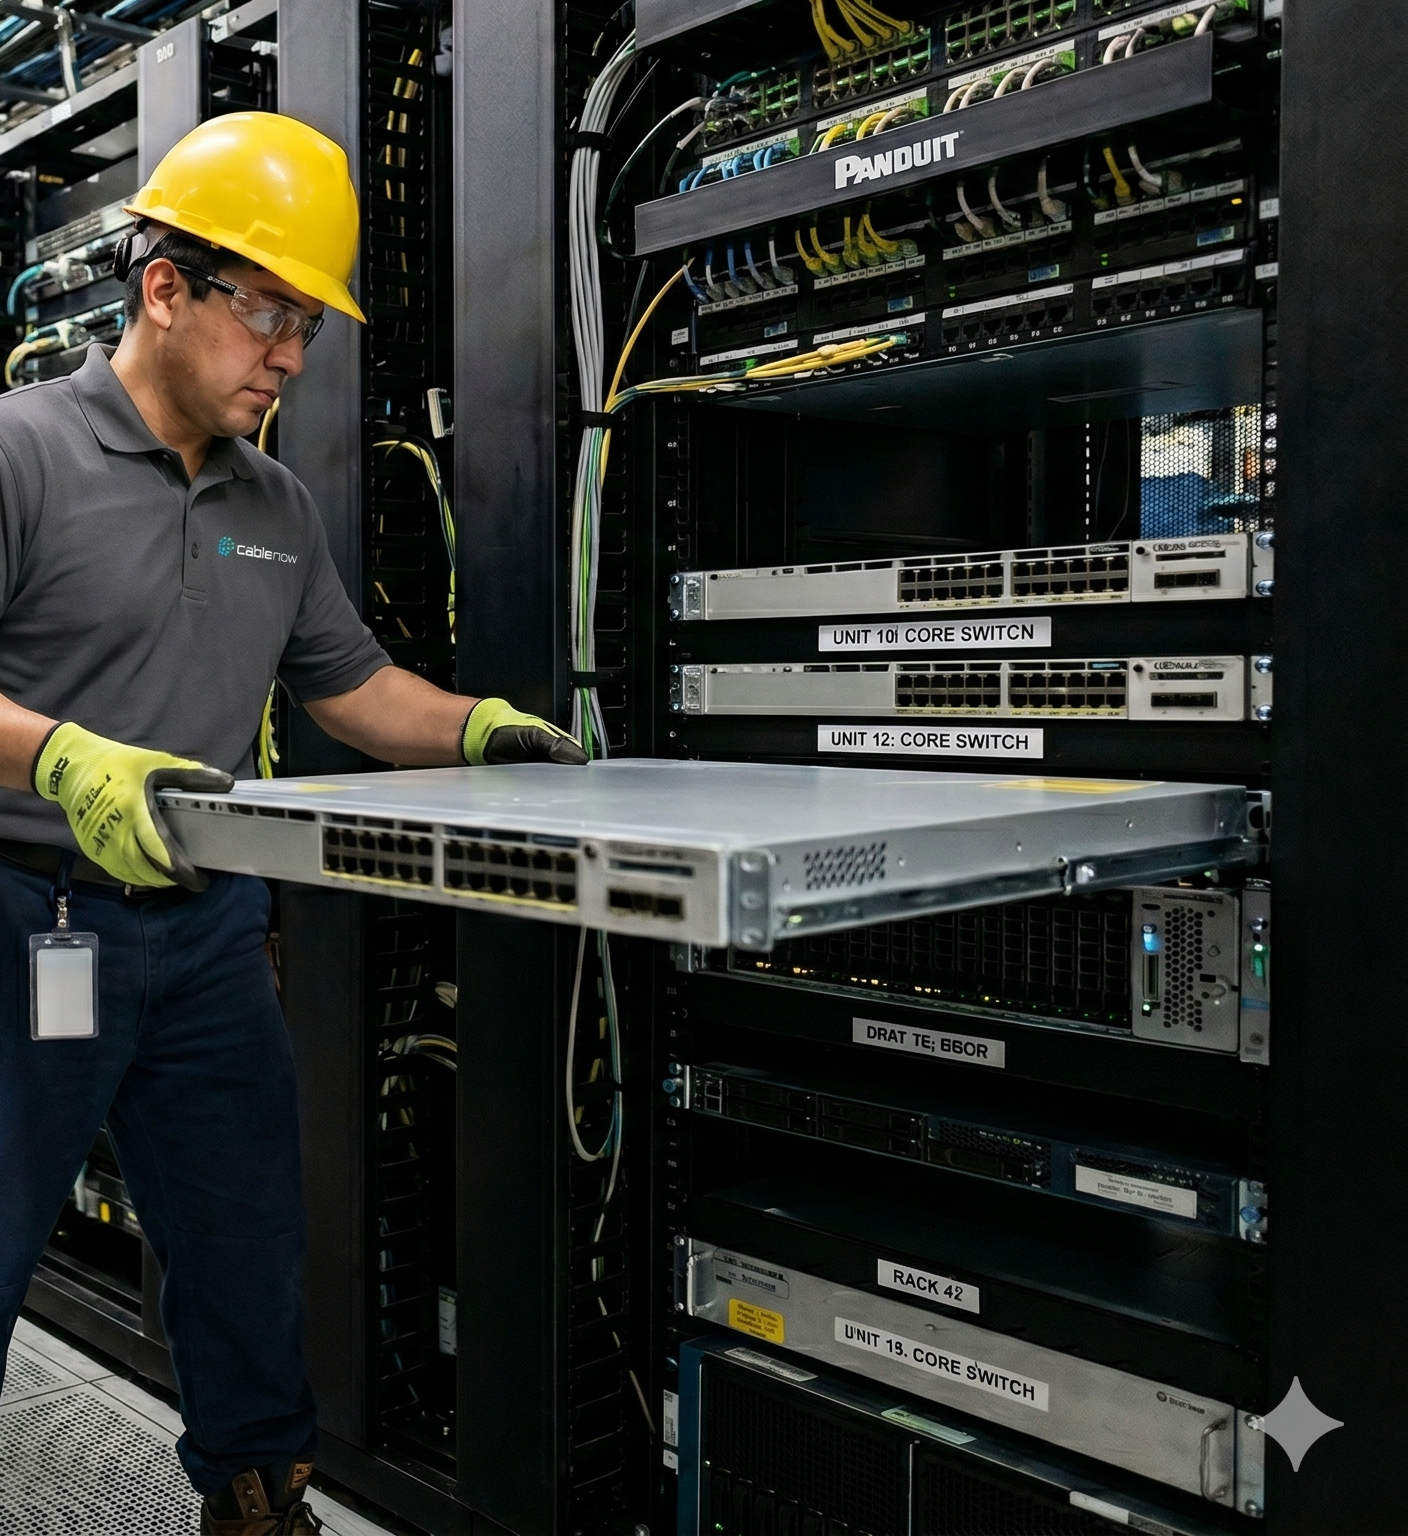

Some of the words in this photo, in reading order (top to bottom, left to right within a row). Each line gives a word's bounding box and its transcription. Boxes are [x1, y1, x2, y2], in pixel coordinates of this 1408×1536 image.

[835, 131, 960, 190] PANDUIT
[236, 544, 298, 564] cablenow
[833, 629, 872, 645] UNIT
[904, 626, 955, 643] CORE
[831, 731, 868, 746] UNIT
[872, 732, 895, 747] 12:
[900, 732, 951, 748] CORE
[955, 733, 1029, 750] SWITCH
[866, 1025, 908, 1045] DRAT
[893, 1268, 939, 1296] RACK
[943, 1284, 964, 1302] 42
[913, 1347, 961, 1376] CORE
[966, 1364, 1035, 1401] SWITCH
